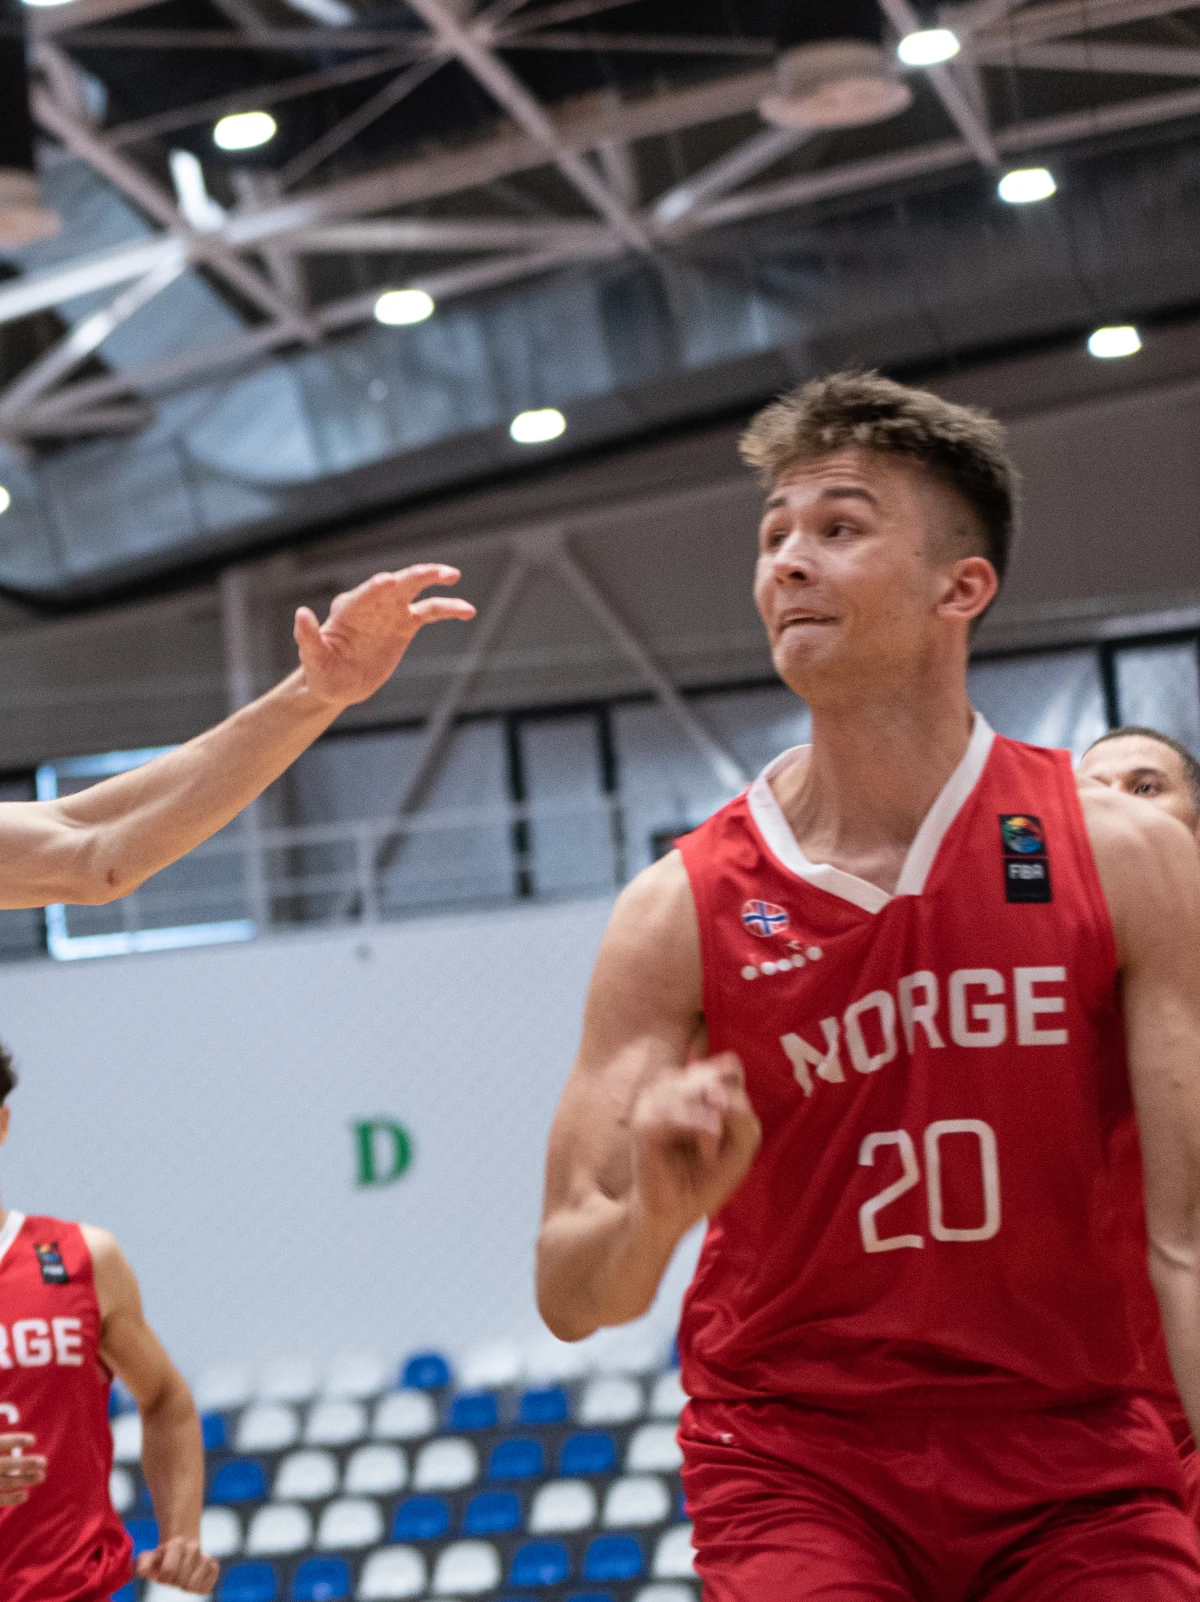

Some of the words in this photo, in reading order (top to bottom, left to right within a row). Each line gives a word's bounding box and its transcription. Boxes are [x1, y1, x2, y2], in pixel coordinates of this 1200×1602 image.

[779, 965, 1069, 1097] NORGE
[349, 1115, 414, 1190] D
[857, 1118, 1002, 1254] 20
